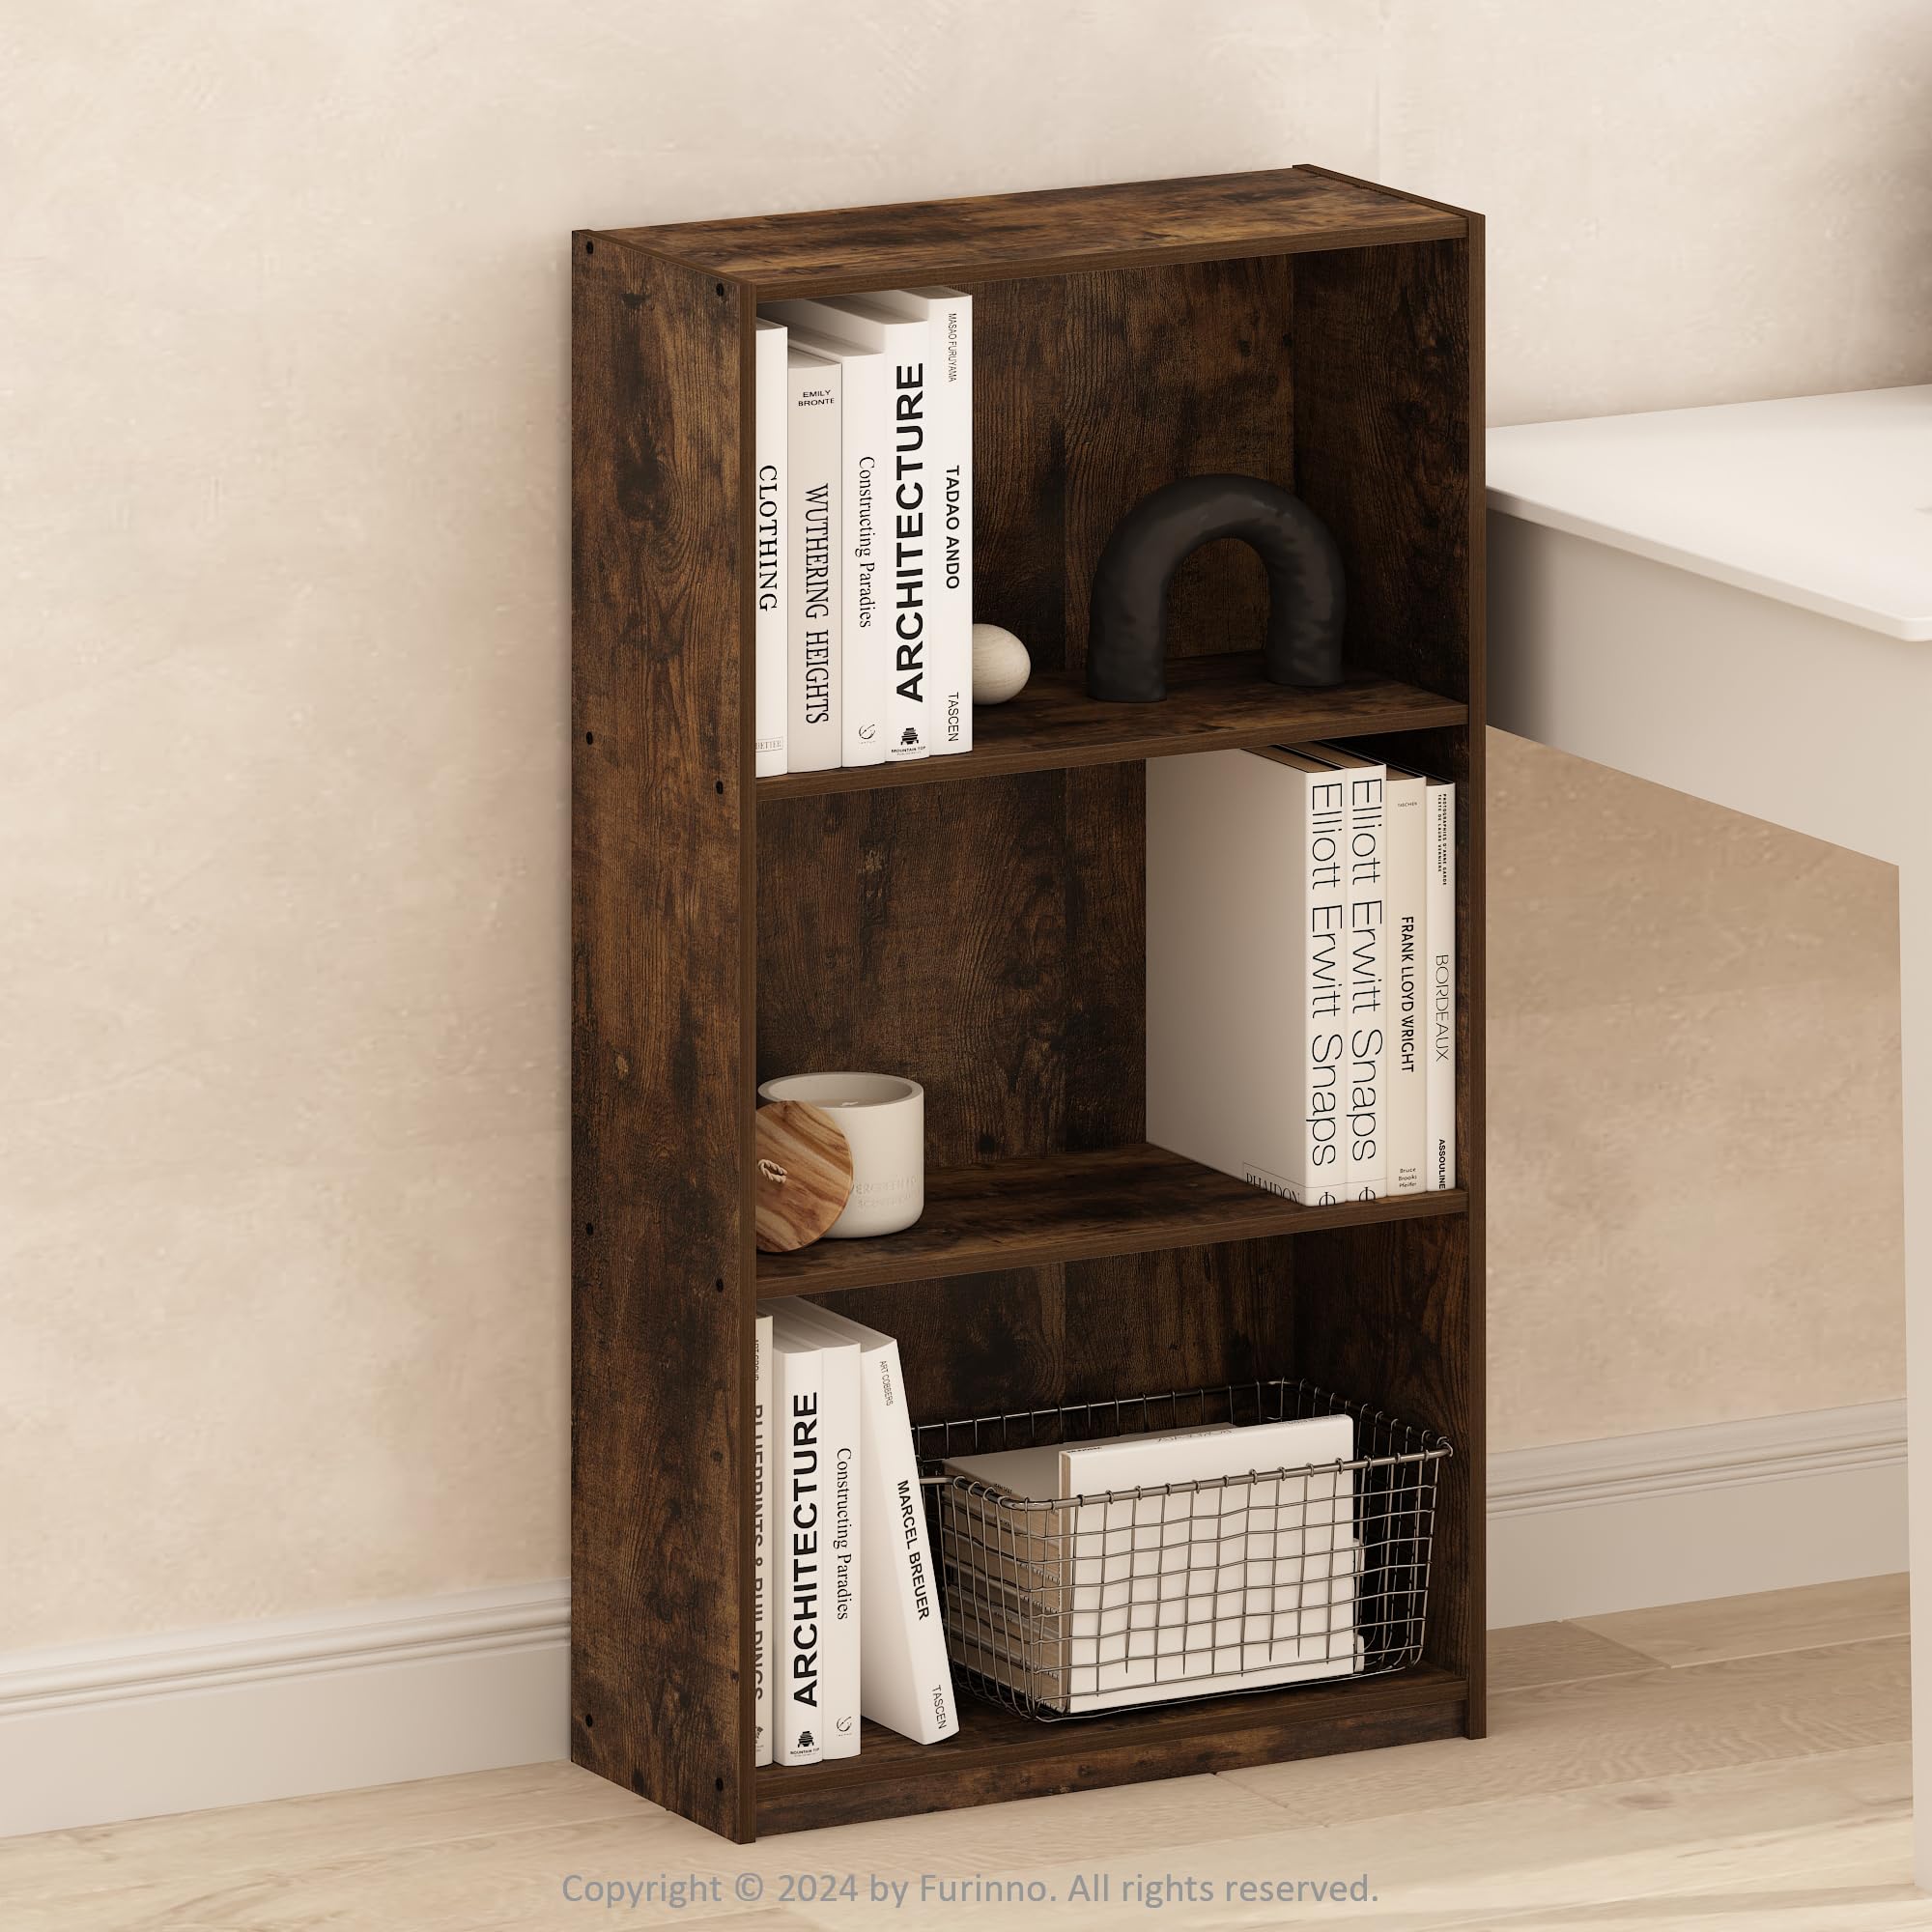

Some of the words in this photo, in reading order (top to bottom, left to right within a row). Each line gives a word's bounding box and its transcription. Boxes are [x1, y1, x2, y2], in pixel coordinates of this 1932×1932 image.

[759, 466, 777, 611] CLOTHING
[855, 457, 875, 557] Constructing
[896, 363, 923, 702] ARCHITECTURE
[947, 466, 959, 529] TADAO
[806, 483, 828, 618] WUTHERING
[860, 562, 875, 627] Paradies
[947, 536, 959, 588] ANDO
[806, 630, 829, 724] HEIGHTS
[949, 692, 958, 741] TASCEN
[1313, 783, 1342, 890] Elliott
[1352, 779, 1381, 885] Elliott
[1313, 905, 1342, 1018] Erwitt
[1352, 900, 1381, 1013] Erwitt
[1402, 917, 1413, 962] FRANK
[1402, 967, 1413, 1011] LLOYD
[1402, 1015, 1414, 1072] WRIGHT
[1436, 955, 1449, 1062] BORDEAUX
[1306, 1035, 1343, 1166] Snaps
[1347, 1030, 1382, 1160] Snaps
[793, 1392, 817, 1707] ARCHITECTURE
[834, 1448, 851, 1548] Constructing
[838, 1554, 851, 1619] Paradies
[897, 1480, 918, 1549] MARCEL
[909, 1551, 929, 1620] BREUER
[932, 1685, 947, 1729] TASCEN
